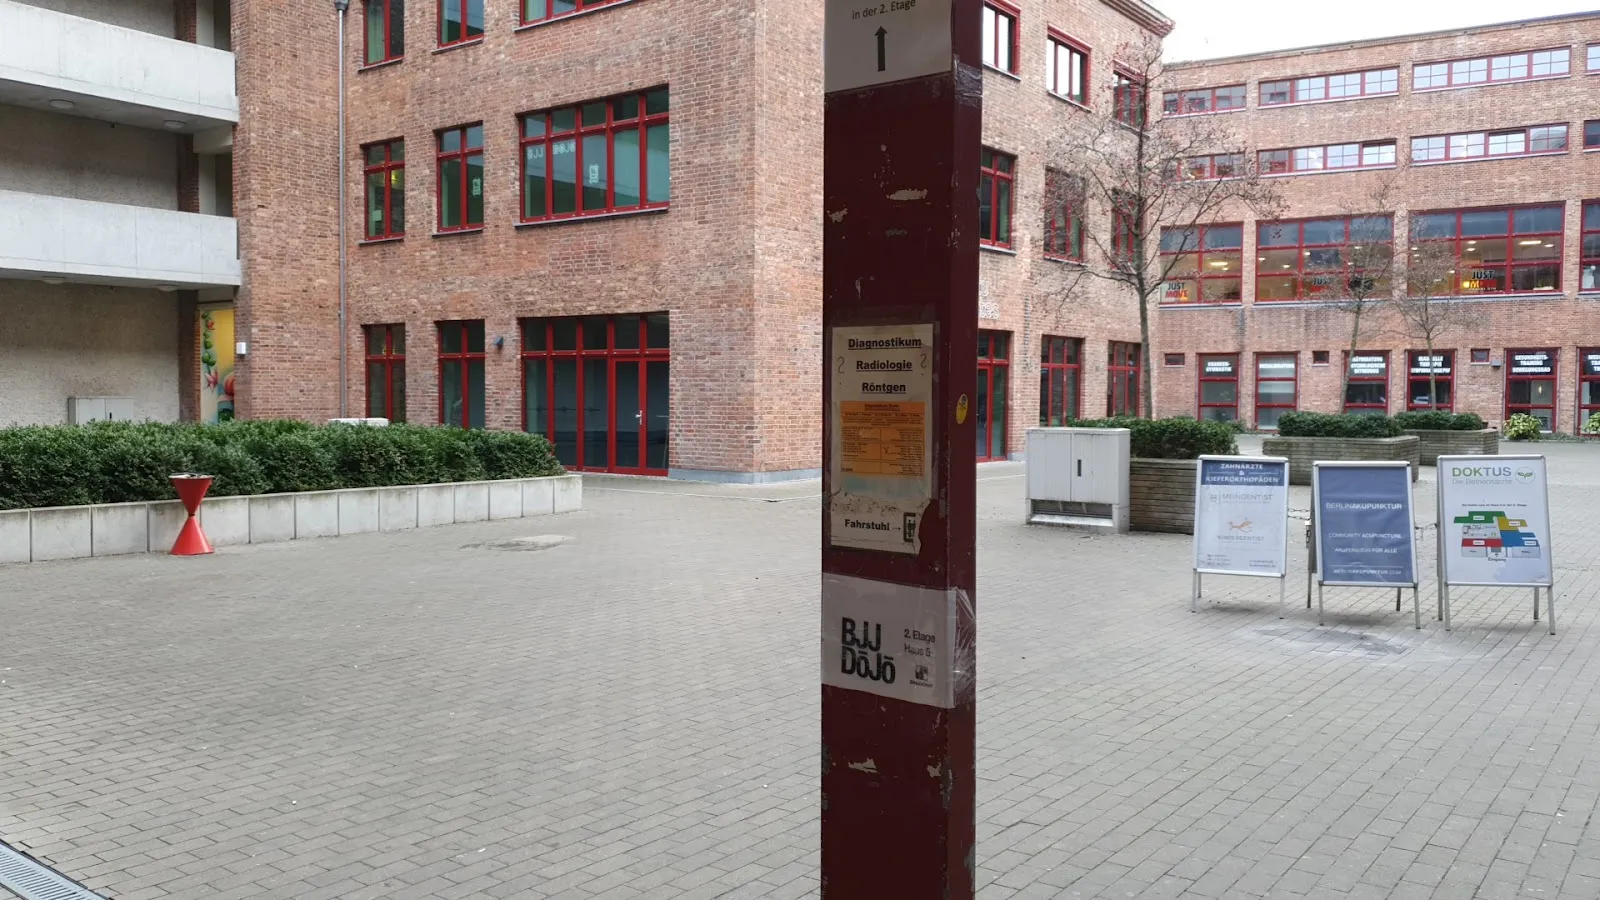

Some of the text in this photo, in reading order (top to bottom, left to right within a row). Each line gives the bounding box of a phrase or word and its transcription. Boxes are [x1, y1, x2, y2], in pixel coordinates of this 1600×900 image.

[852, 0, 916, 20] in der 2. Etage
[1472, 271, 1494, 279] JUST
[1168, 281, 1186, 290] JUST
[1165, 290, 1189, 298] MOVE
[848, 337, 922, 349] Diagnostikum
[856, 360, 913, 371] Radiologie
[862, 382, 906, 394] Röntgen
[1452, 467, 1512, 477] DOKTUS
[1326, 502, 1403, 510] BERLINAKUPUNKTUR
[844, 518, 890, 531] Fahrstuhl
[841, 617, 882, 652] BJJ
[904, 628, 936, 645] 2. Etage
[904, 644, 931, 657] Haus 5
